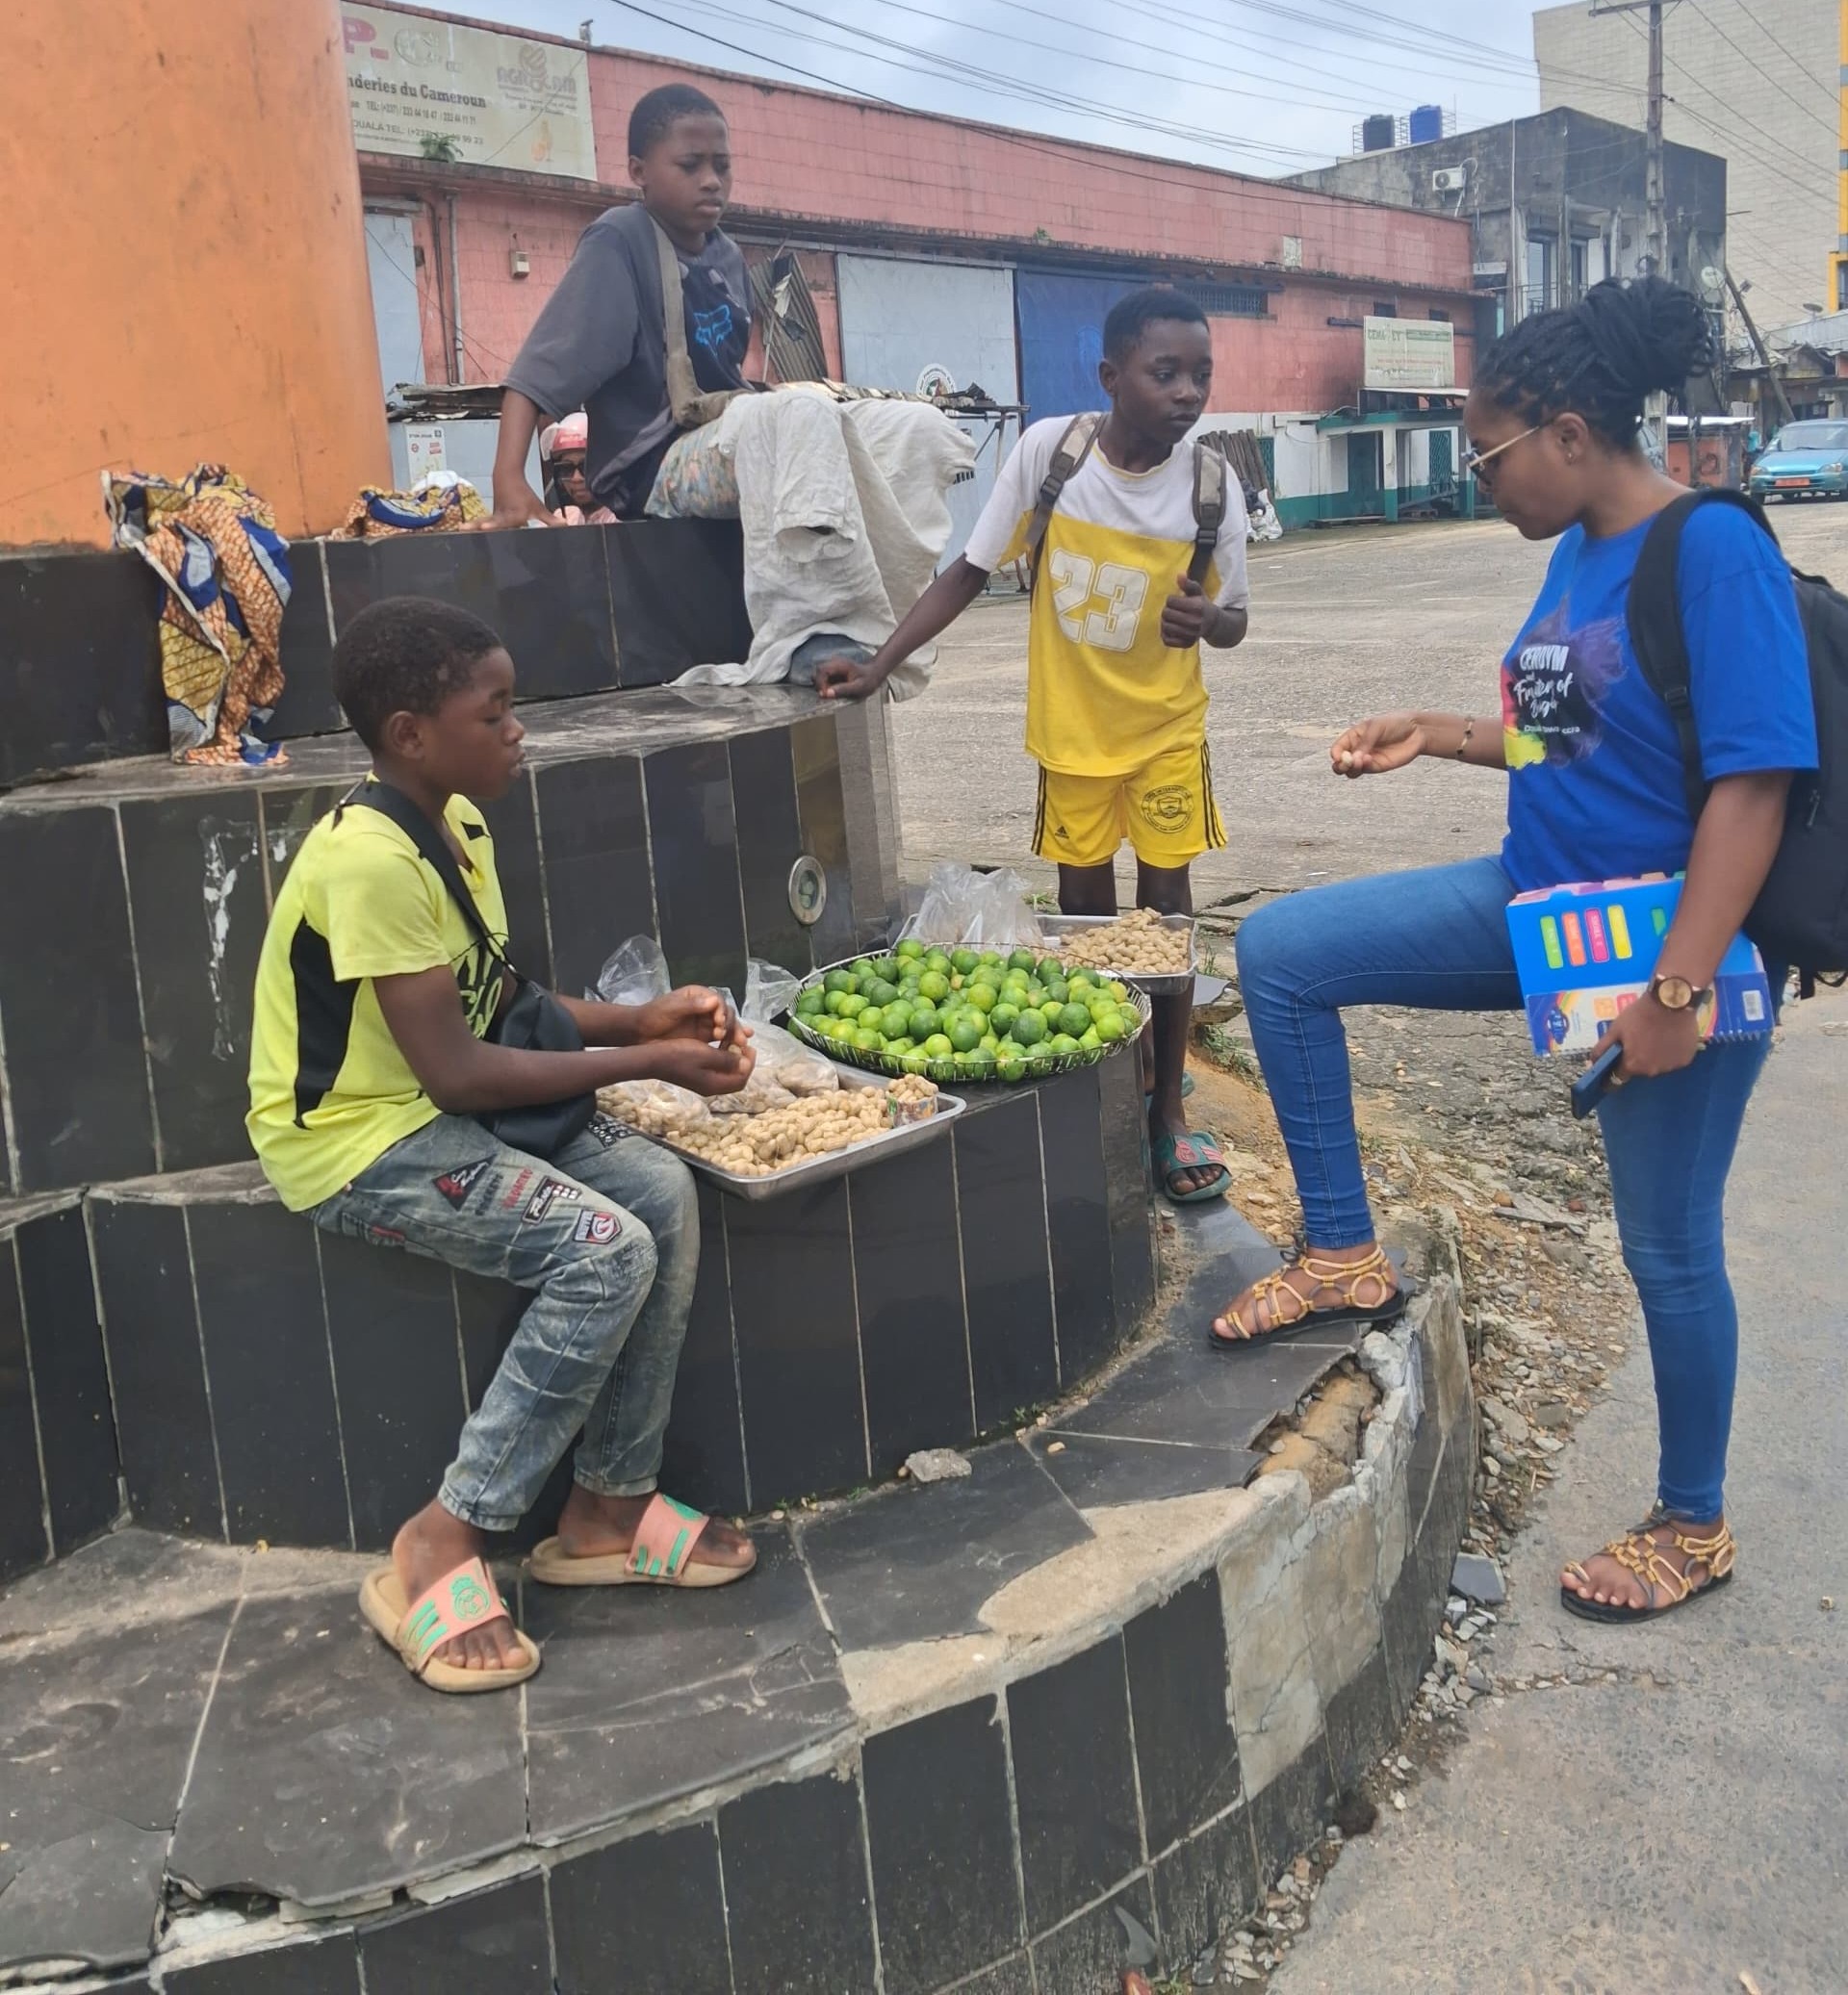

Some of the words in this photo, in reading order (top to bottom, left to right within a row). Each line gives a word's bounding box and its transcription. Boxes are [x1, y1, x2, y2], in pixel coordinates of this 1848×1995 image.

[400, 81, 418, 98] du
[420, 84, 487, 108] Cameroun
[1049, 547, 1149, 653] 23
